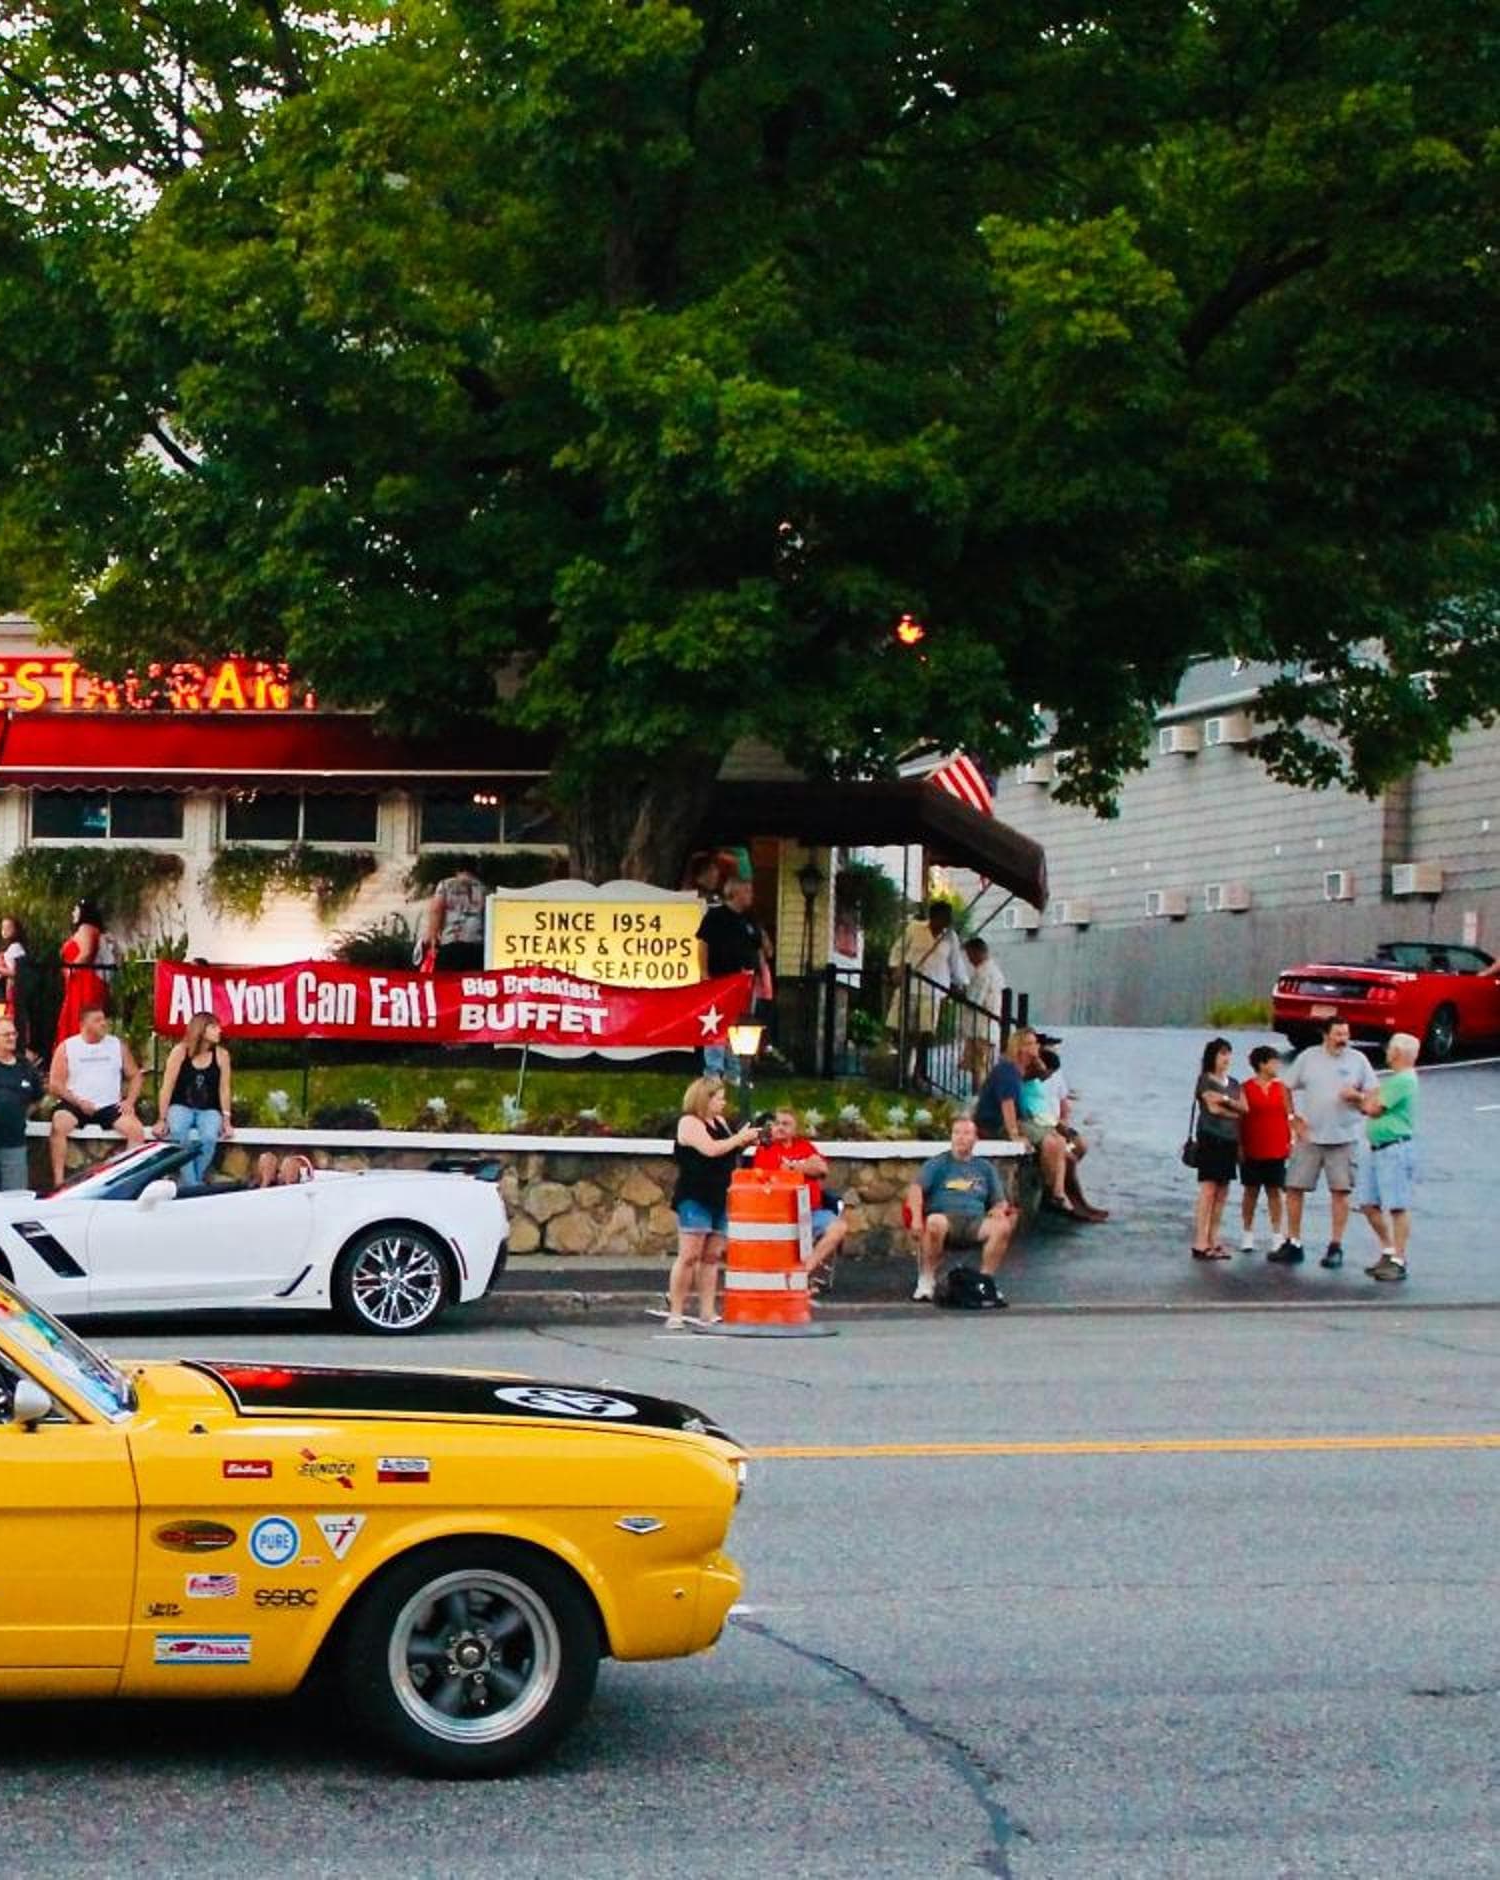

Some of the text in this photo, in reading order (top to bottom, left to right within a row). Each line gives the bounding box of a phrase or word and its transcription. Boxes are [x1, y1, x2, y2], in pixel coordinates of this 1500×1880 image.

[535, 911, 662, 933] SINCE 1954
[505, 935, 692, 958] STEAKS & CHOPS
[592, 960, 689, 981] SEAFOOD
[461, 975, 602, 1000] Big Breakfast
[168, 970, 438, 1029] All You Can Eat!
[458, 1001, 609, 1036] BUFFET
[300, 1462, 357, 1476] SUNOCO
[260, 1534, 291, 1550] PURE
[254, 1589, 319, 1607] SSBC
